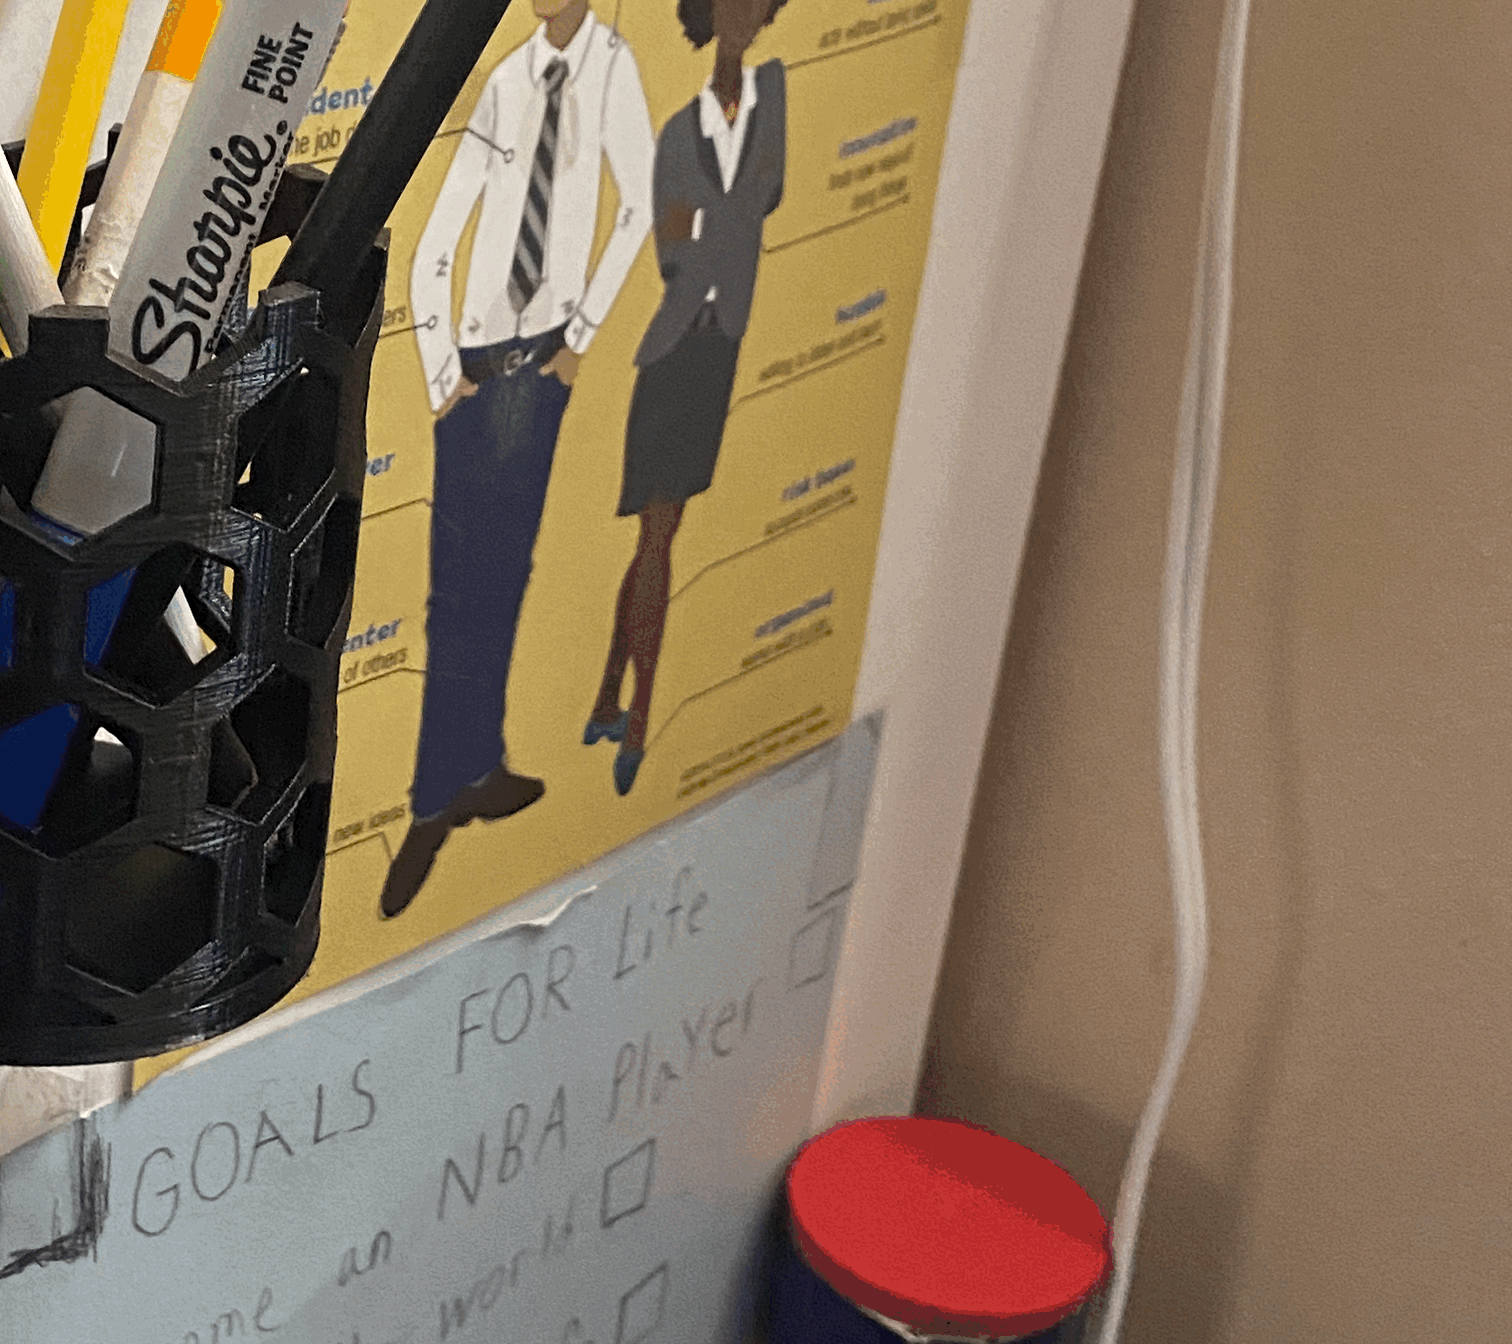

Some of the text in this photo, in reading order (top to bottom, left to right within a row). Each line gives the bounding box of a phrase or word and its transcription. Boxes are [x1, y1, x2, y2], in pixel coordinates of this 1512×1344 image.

[242, 34, 283, 96] FINE
[268, 21, 314, 105] POINT
[312, 123, 341, 158] job
[130, 866, 709, 1239] GOALS FOR Life
[335, 1226, 394, 1289] an
[435, 1082, 568, 1222] NBA
[437, 1194, 576, 1343] world
